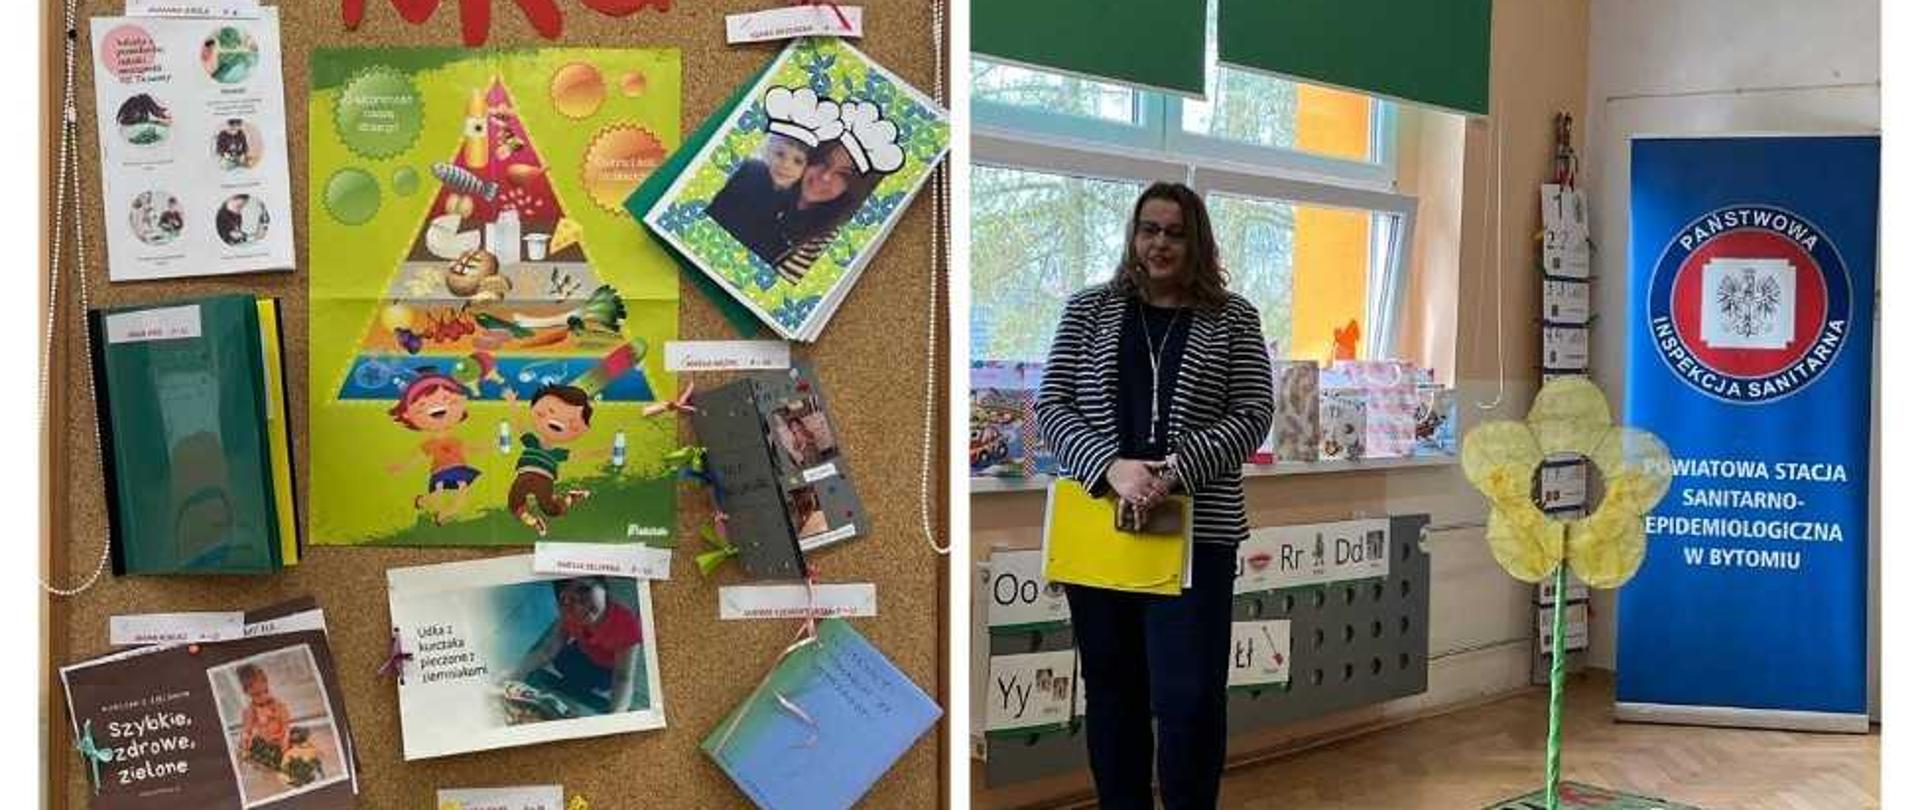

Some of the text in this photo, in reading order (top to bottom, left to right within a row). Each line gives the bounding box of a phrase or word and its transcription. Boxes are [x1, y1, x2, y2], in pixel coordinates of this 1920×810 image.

[1679, 209, 1819, 251] PAŃSTWOWA
[1653, 316, 1845, 397] INSPEKCJA SANITARNA
[1775, 462, 1848, 482] STACJA
[1682, 488, 1806, 510] SANITARNO-
[1645, 515, 1844, 542] EPIDEMIOLOGICZNA
[1281, 544, 1304, 571] Rr
[1335, 536, 1363, 565] Dd
[1684, 547, 1801, 569] W BYTOMIU
[994, 573, 1038, 605] Oo
[419, 637, 465, 652] kurczaka
[997, 675, 1032, 719] Yy
[114, 736, 196, 762] zdrowe,
[118, 760, 188, 784] zielone
